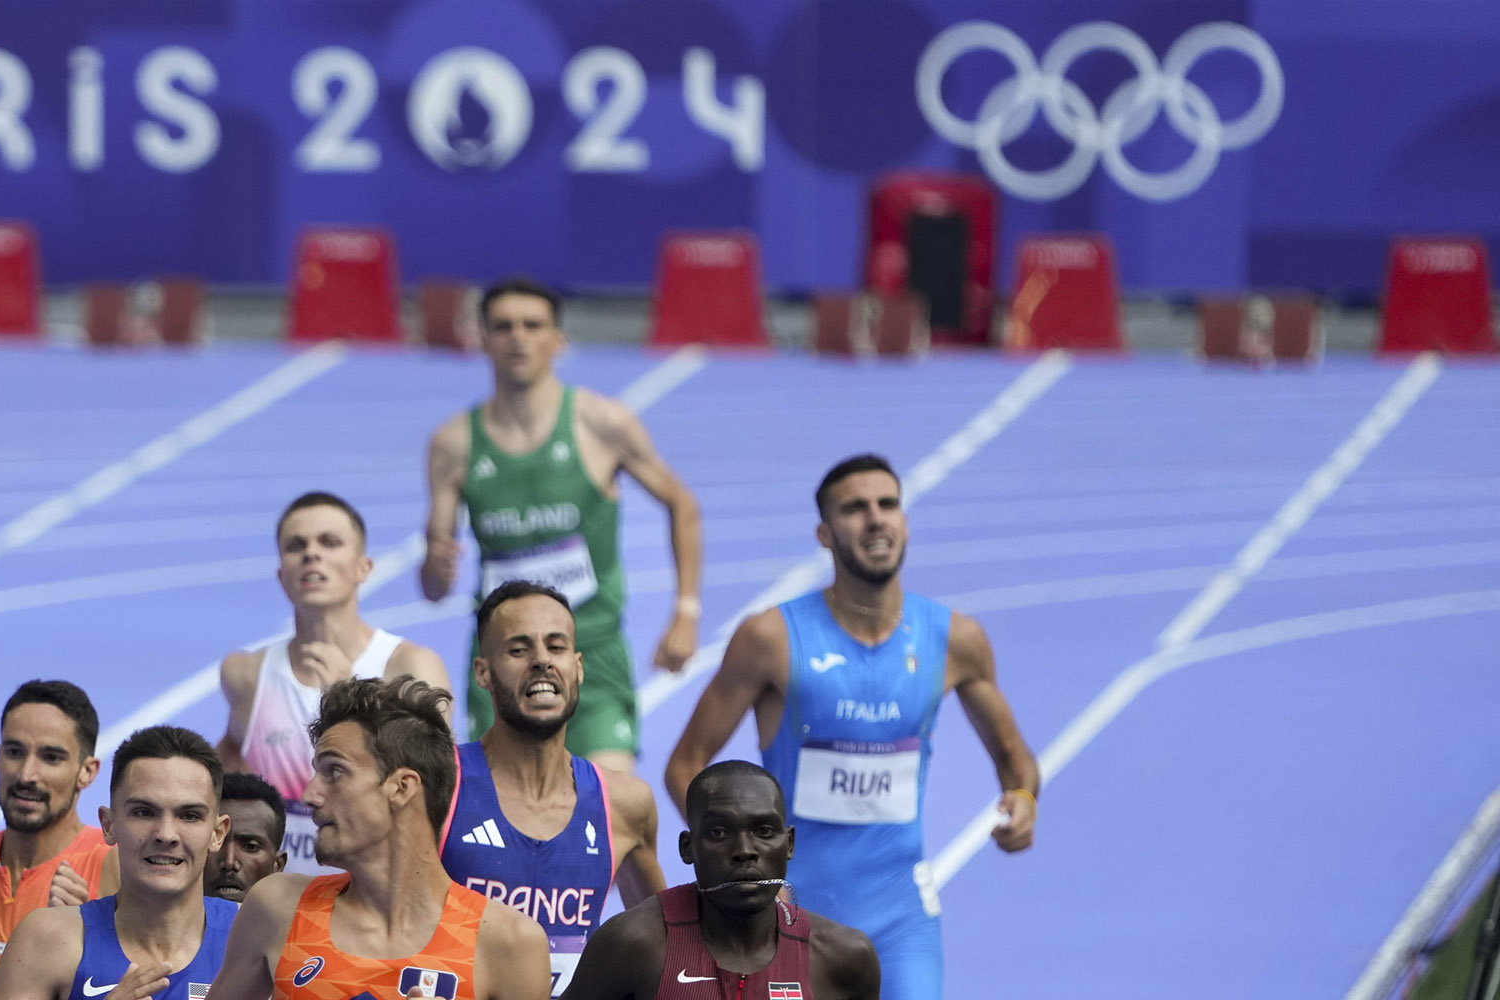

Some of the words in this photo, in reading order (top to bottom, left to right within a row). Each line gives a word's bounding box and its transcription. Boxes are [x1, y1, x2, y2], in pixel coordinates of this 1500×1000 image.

[291, 44, 768, 172] 2024
[835, 699, 901, 722] ITALIA
[465, 877, 595, 926] FRANCE
